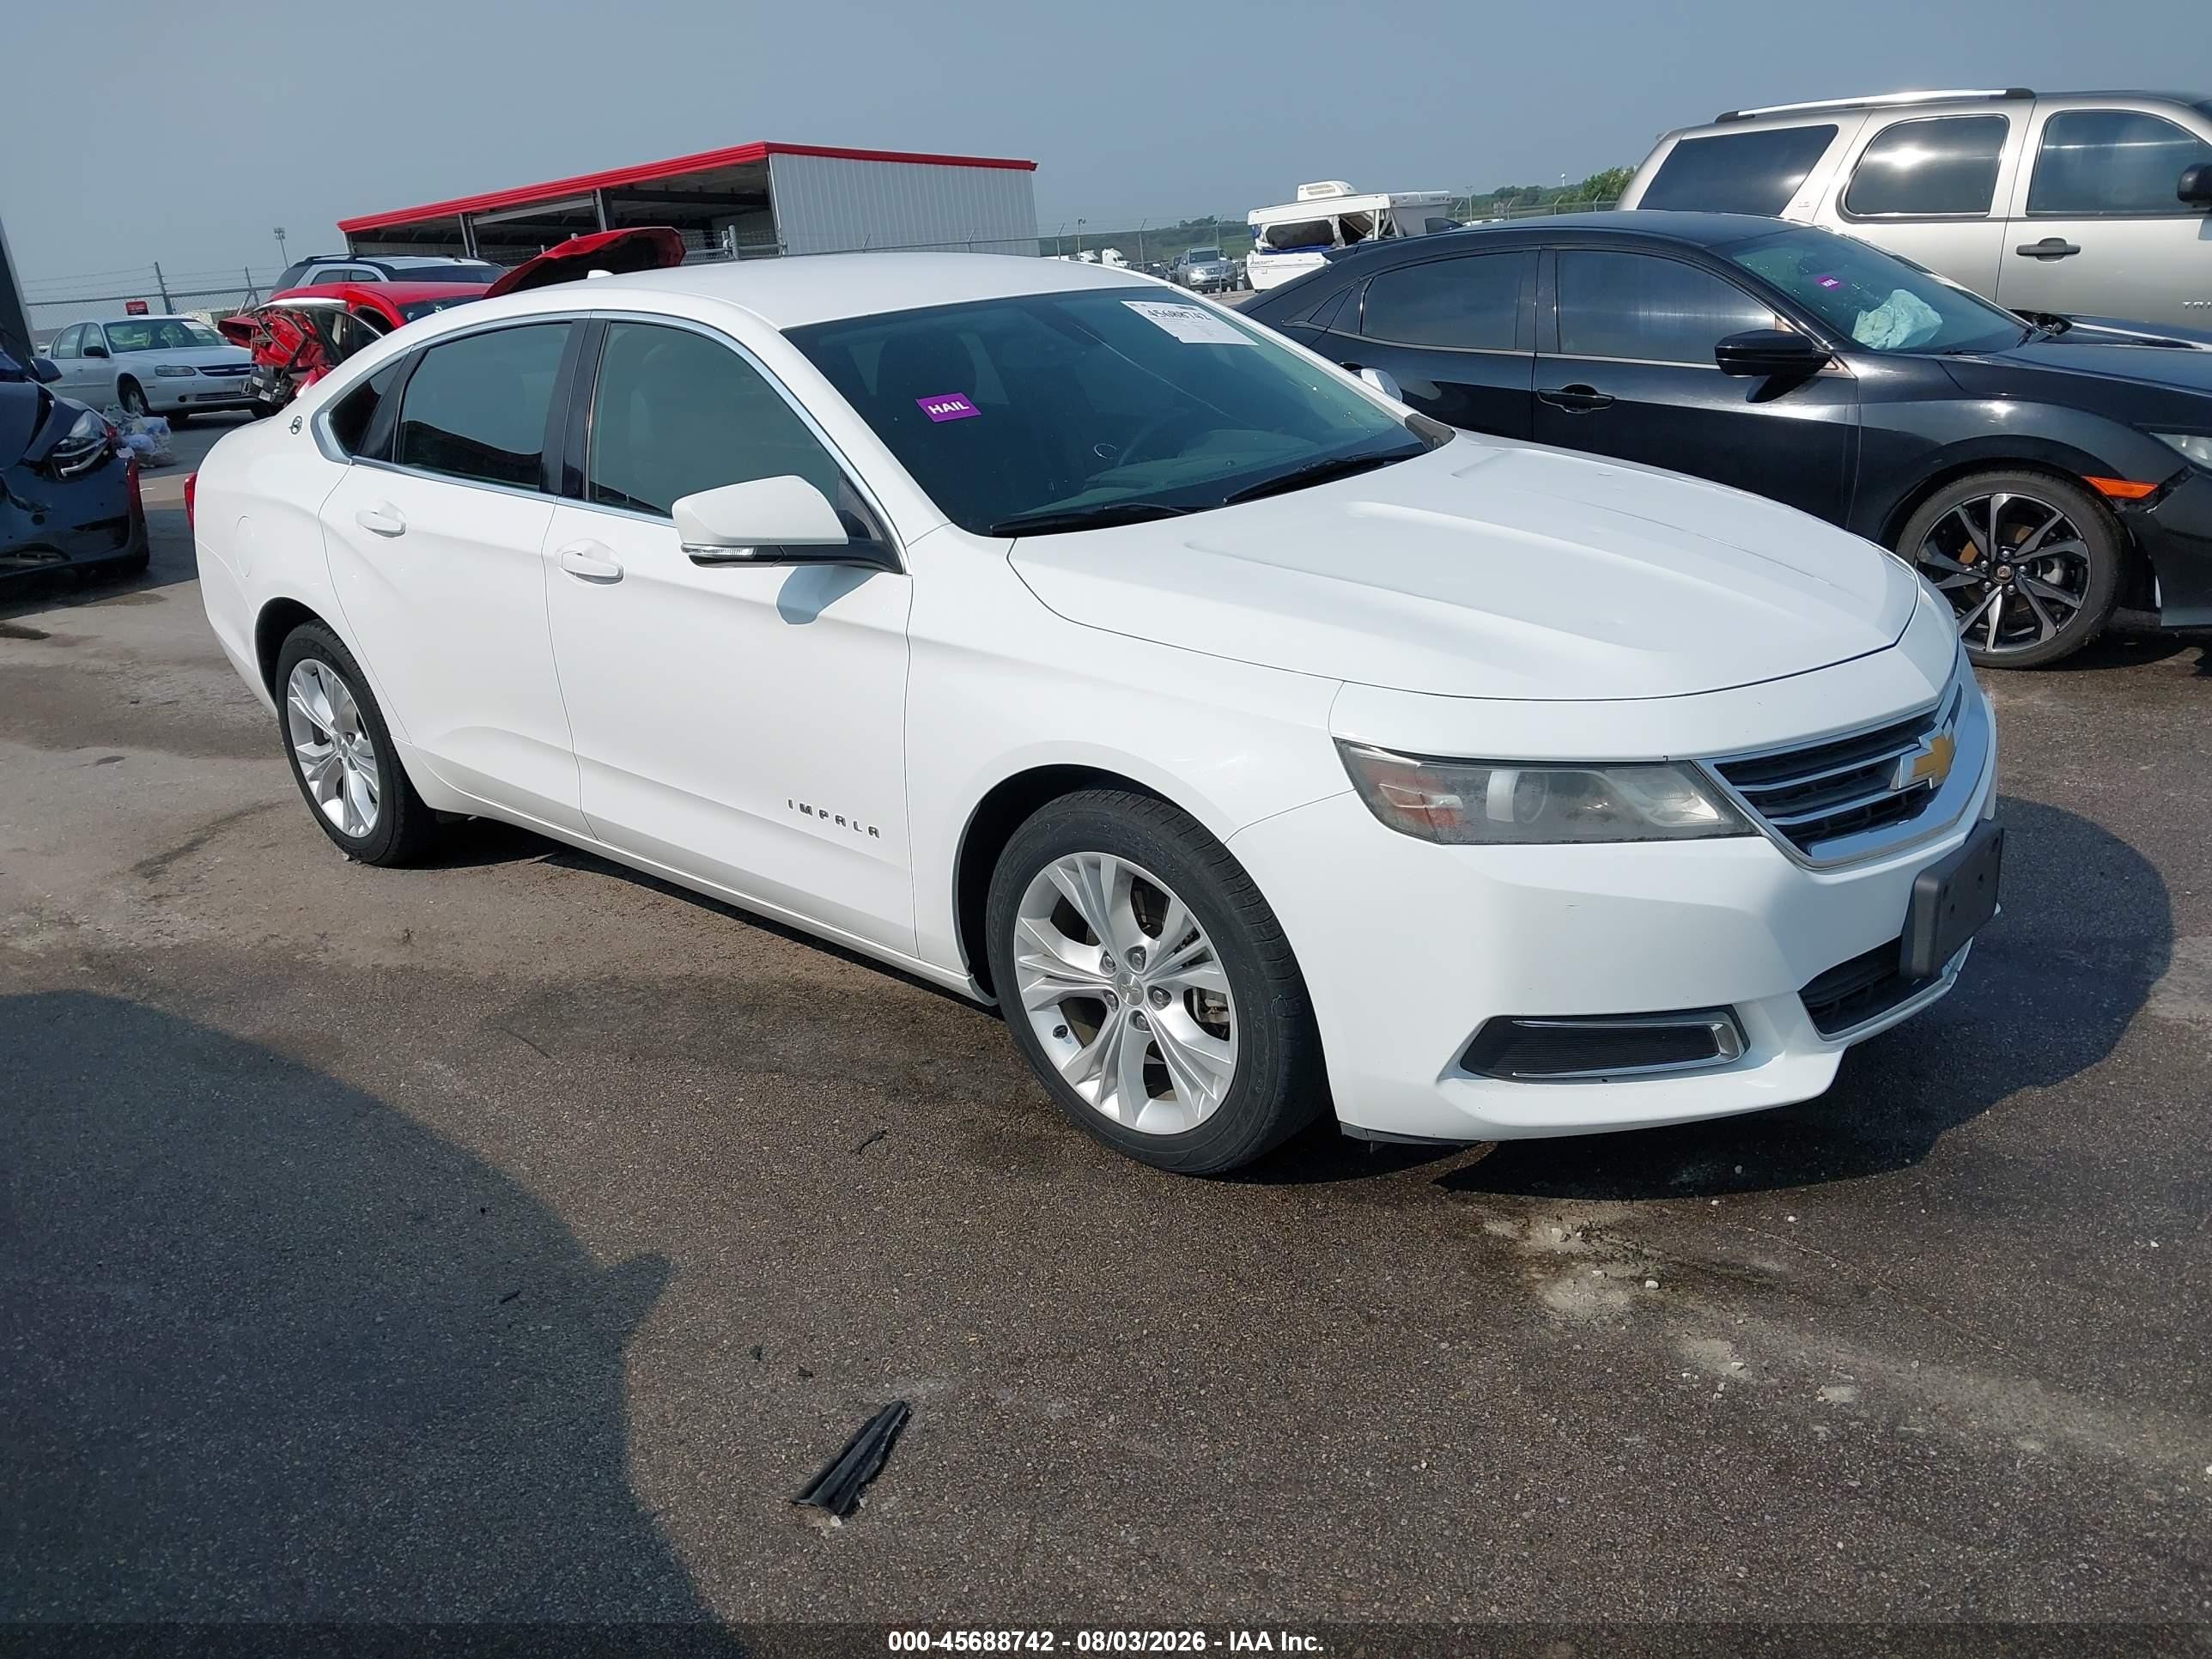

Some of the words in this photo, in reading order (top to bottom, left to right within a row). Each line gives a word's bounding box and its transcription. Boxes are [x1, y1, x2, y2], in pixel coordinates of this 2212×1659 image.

[1147, 309, 1212, 321] 45688742
[927, 401, 969, 415] HAIL
[787, 799, 880, 839] IMPALA
